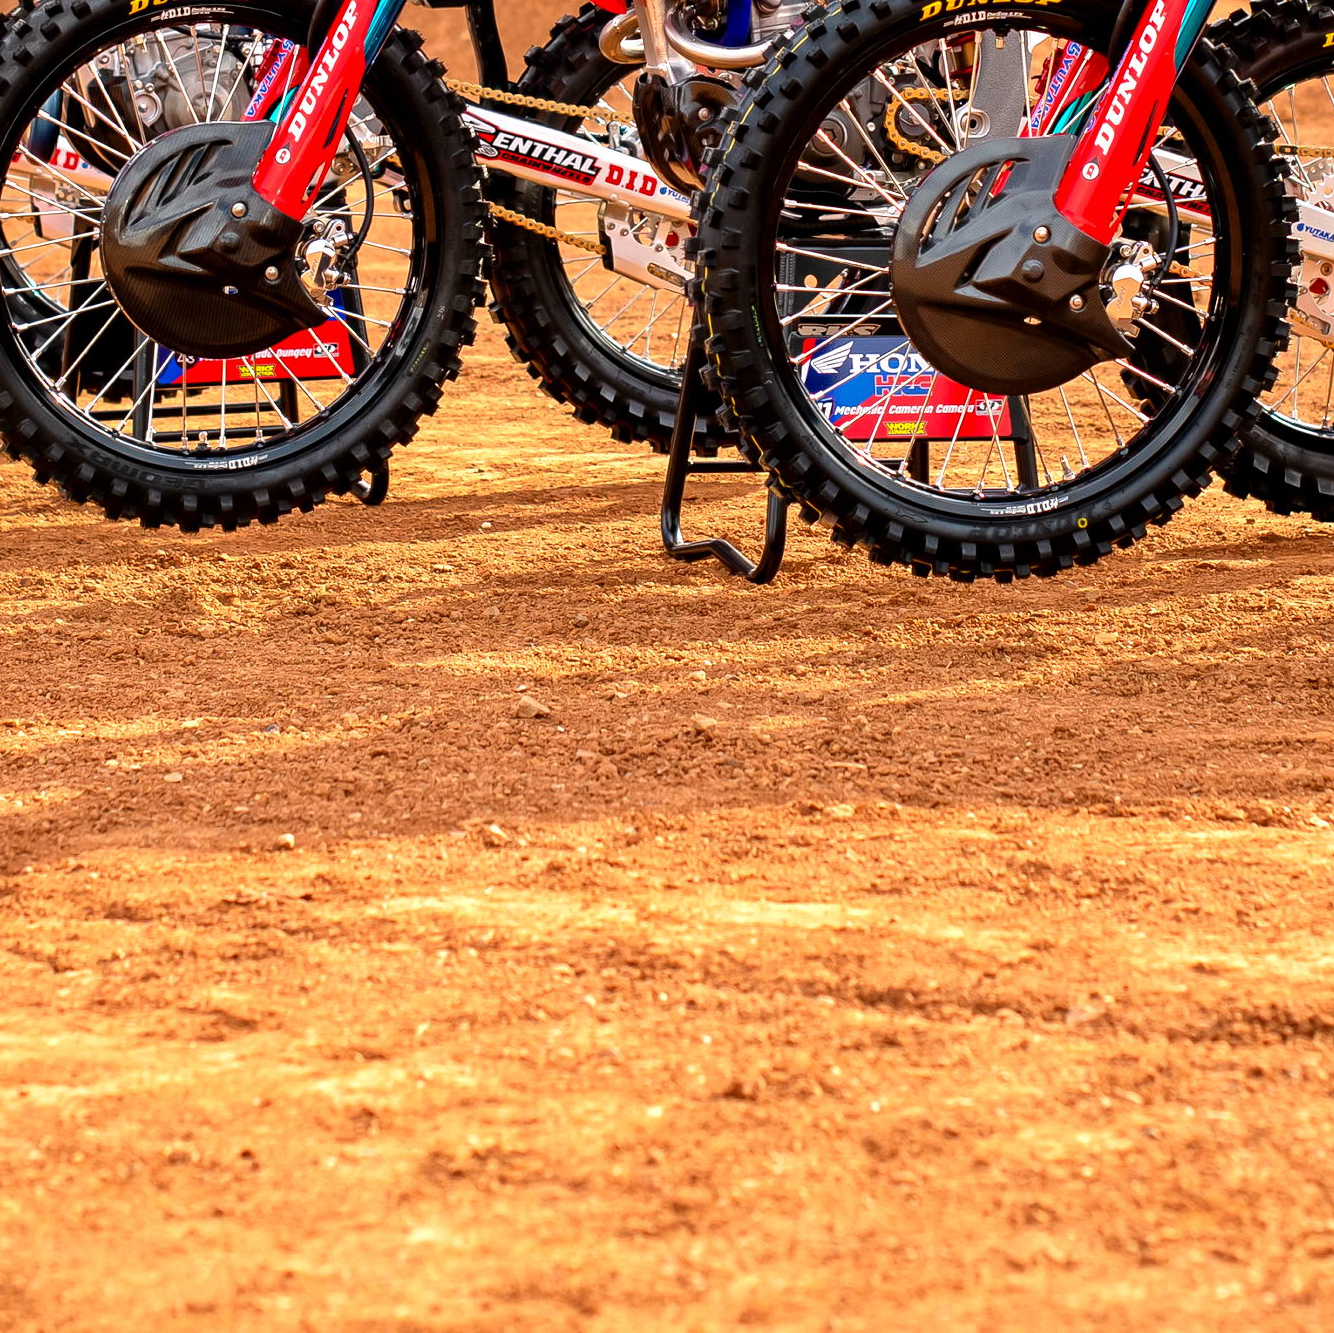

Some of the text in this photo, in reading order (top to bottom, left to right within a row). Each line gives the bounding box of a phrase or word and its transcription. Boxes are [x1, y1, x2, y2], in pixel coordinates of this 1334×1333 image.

[246, 51, 289, 117] YUTAKA
[287, 0, 359, 143] DUNLOP
[1095, 0, 1166, 156] DUNLOP
[498, 151, 595, 185] CHAINWHEELS
[604, 163, 658, 198] D.I.D
[274, 348, 313, 359] Dungey
[849, 354, 935, 374] HON
[874, 374, 933, 397] HRC
